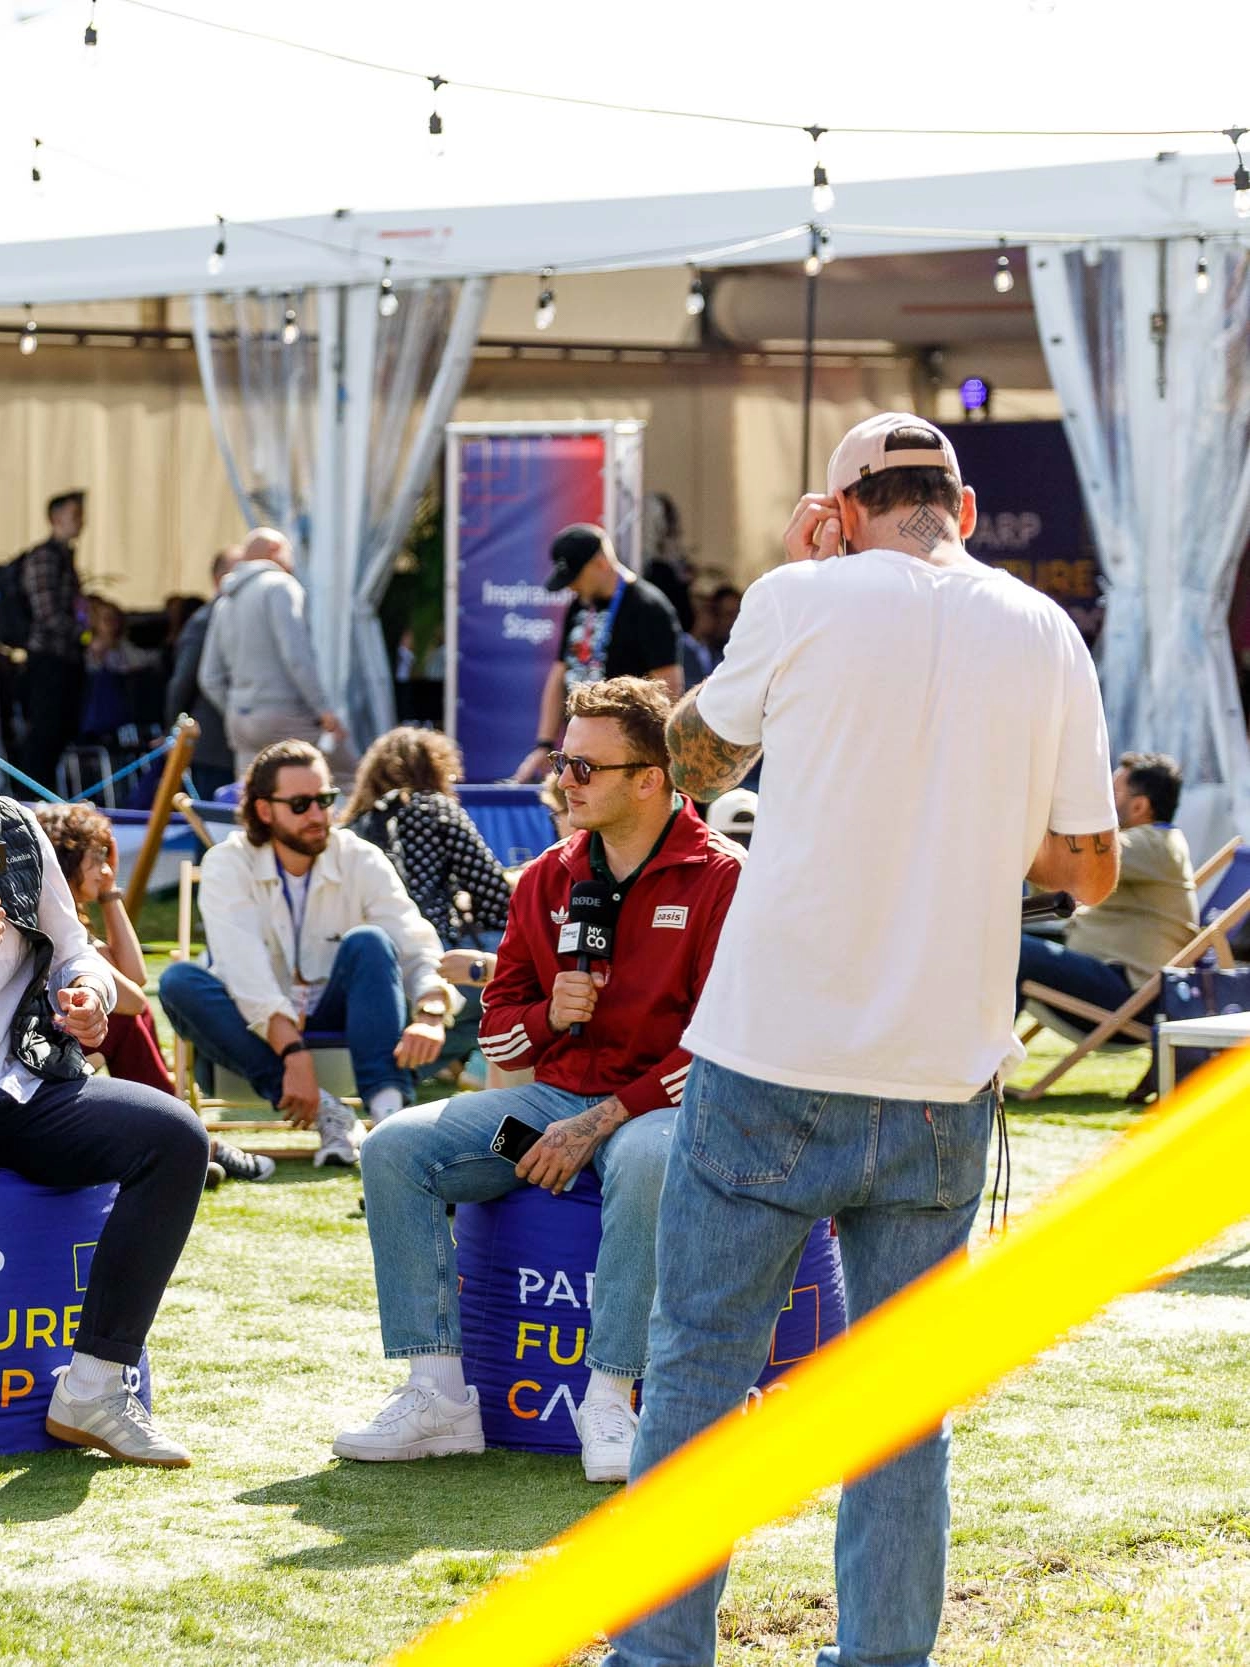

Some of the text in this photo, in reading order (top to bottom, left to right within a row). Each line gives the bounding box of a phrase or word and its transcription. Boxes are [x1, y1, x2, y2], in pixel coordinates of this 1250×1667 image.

[975, 511, 1041, 547] ARP
[572, 896, 601, 907] RØDE
[657, 911, 680, 921] oasis
[587, 926, 602, 936] MY
[586, 935, 607, 949] CO
[518, 1267, 596, 1309] PA
